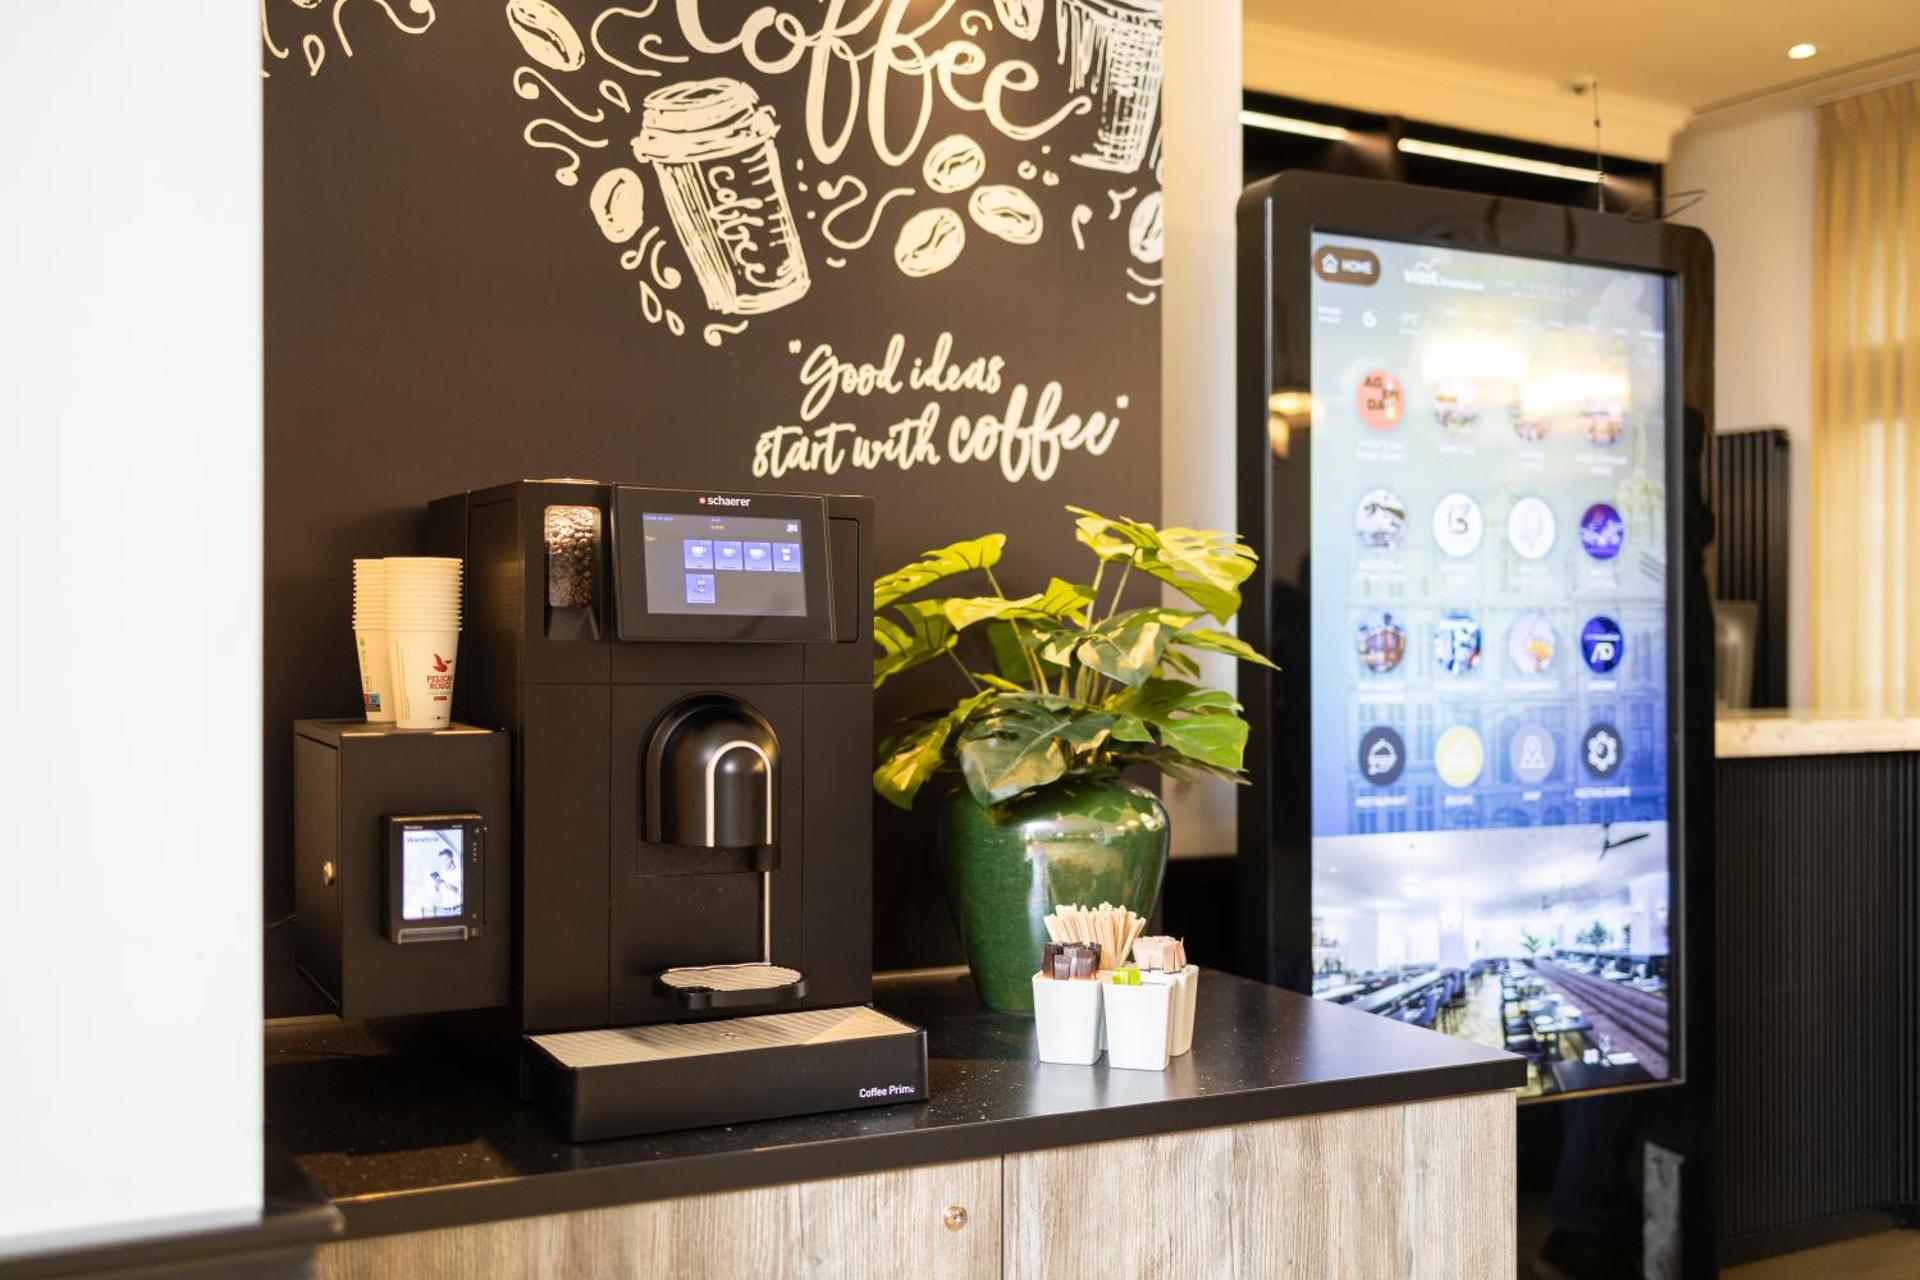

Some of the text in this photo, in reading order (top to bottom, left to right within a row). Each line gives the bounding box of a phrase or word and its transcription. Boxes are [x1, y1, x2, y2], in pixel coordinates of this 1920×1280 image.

[1341, 258, 1374, 275] HOME
[909, 332, 1005, 394] ideas
[752, 422, 857, 478] start
[851, 402, 941, 470] with
[707, 495, 751, 507] schaerer
[859, 1087, 888, 1098] Coffee
